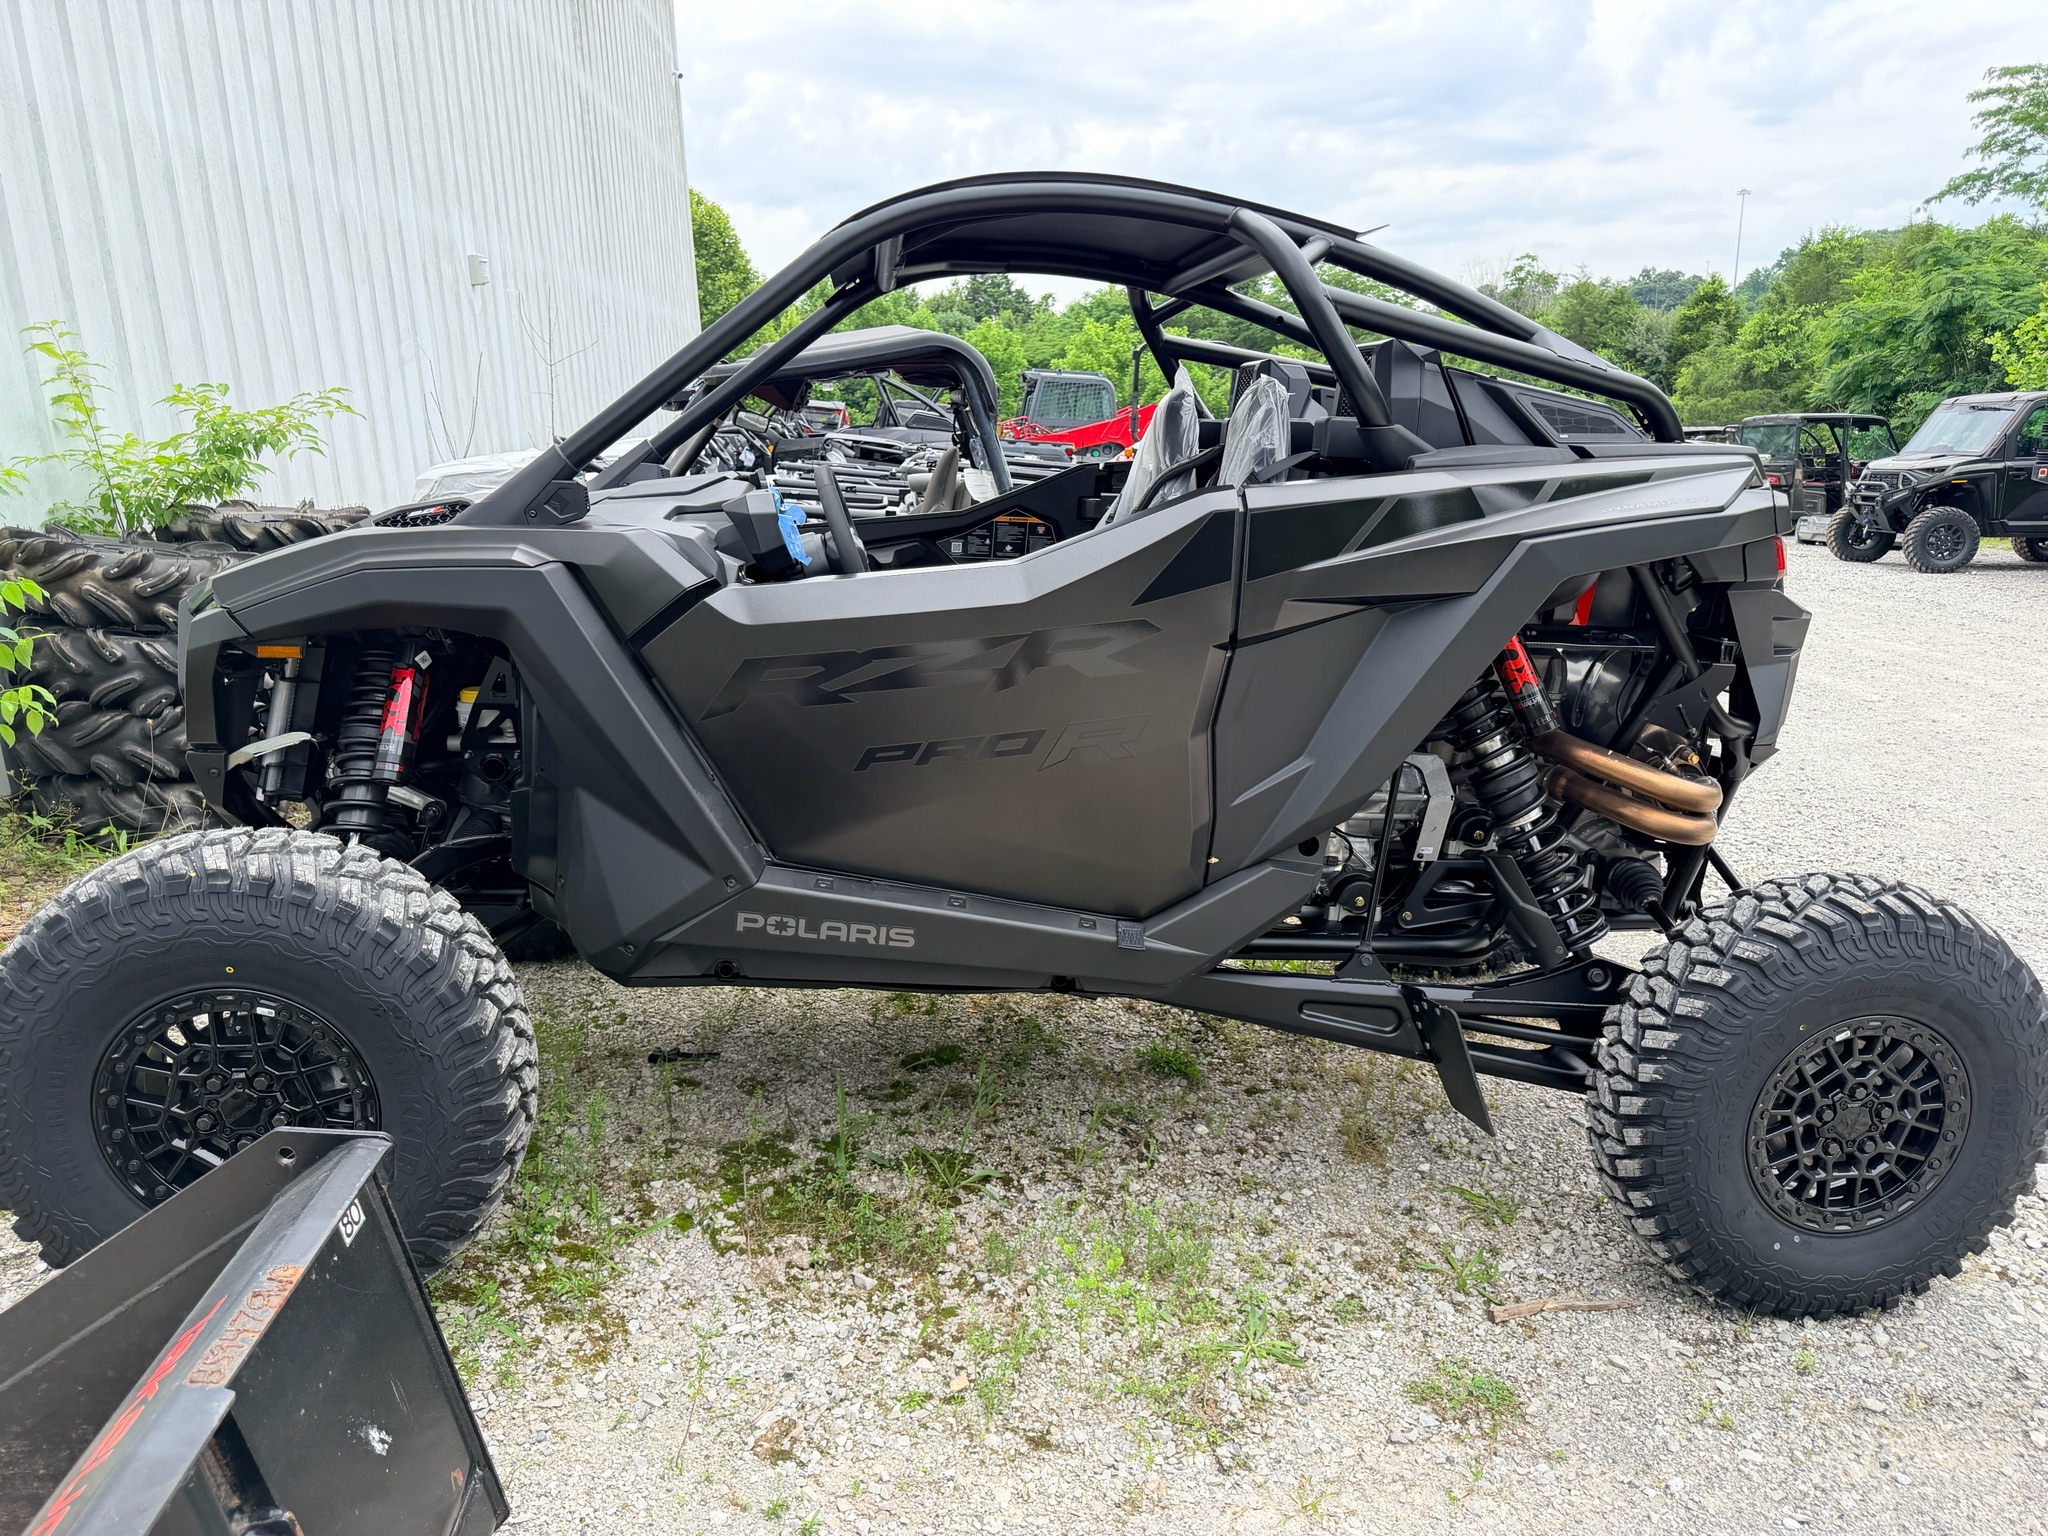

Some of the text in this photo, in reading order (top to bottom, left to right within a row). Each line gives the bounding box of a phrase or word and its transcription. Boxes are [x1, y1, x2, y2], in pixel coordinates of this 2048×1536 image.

[697, 618, 1164, 722] RZR
[851, 728, 1049, 774] PRO
[735, 911, 917, 948] POLARIS
[341, 1201, 361, 1239] 80
